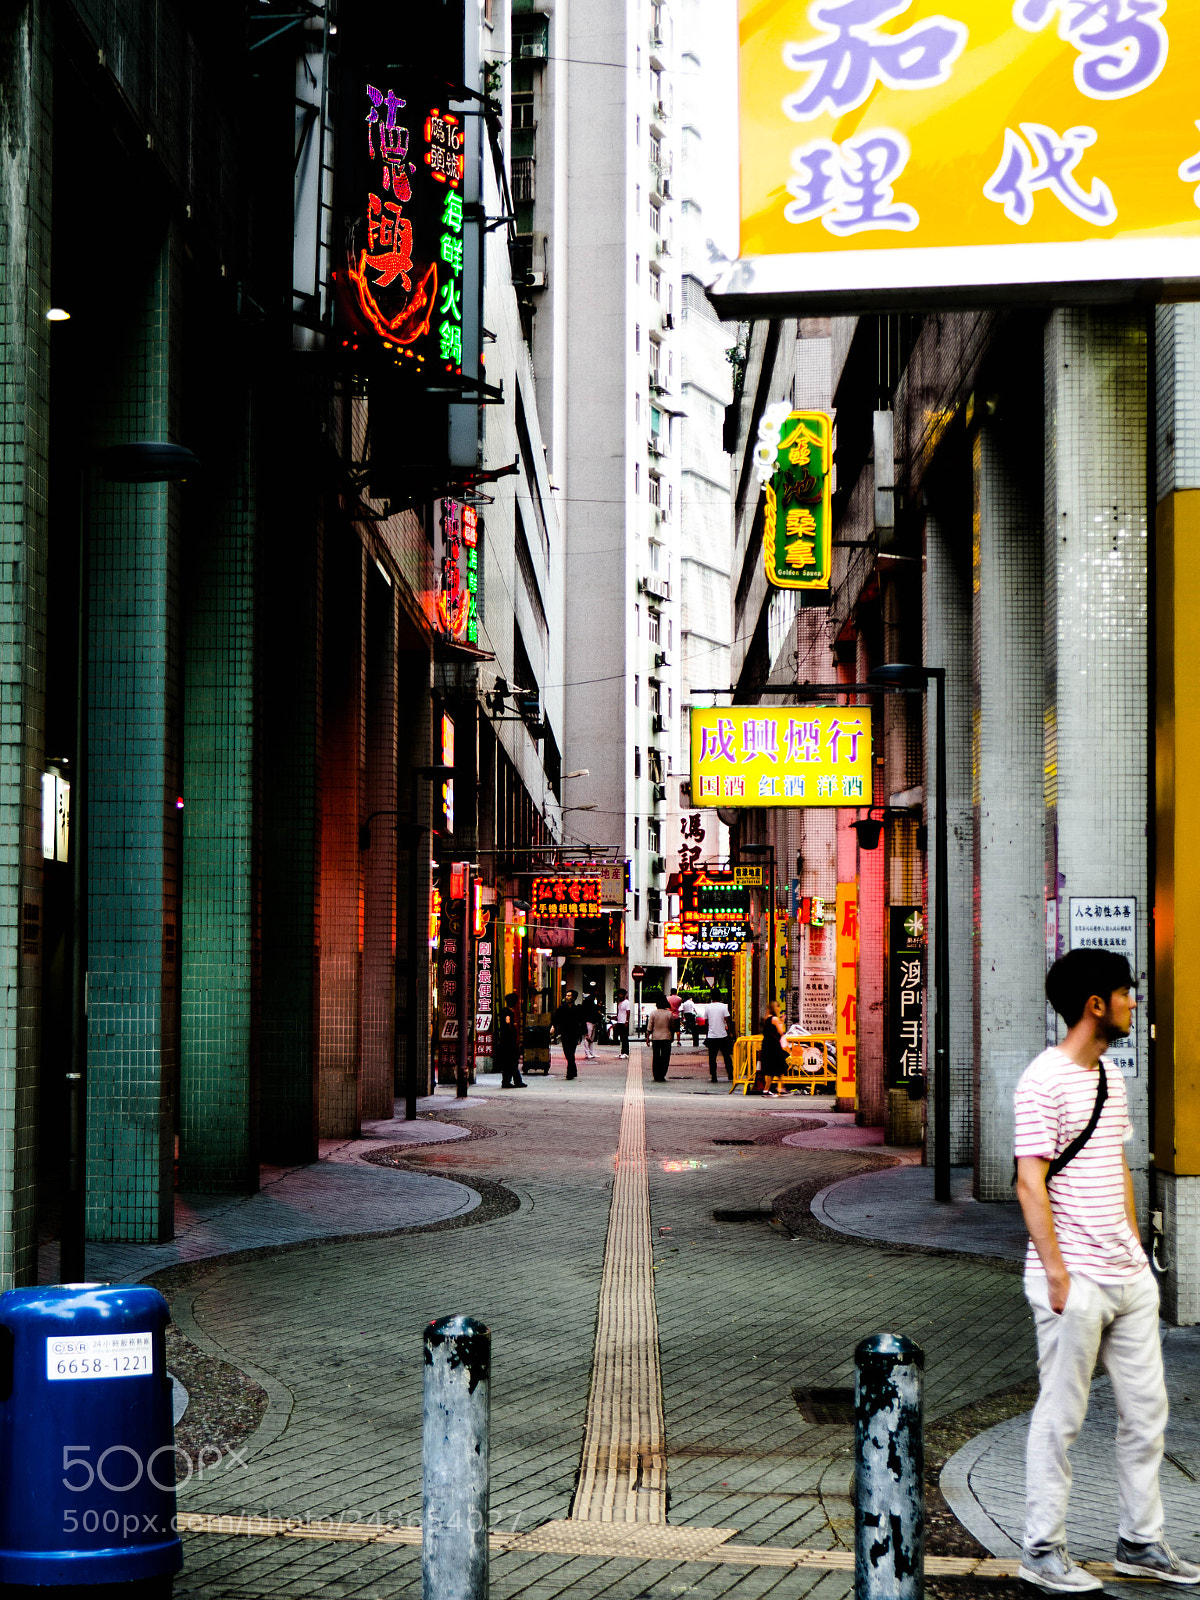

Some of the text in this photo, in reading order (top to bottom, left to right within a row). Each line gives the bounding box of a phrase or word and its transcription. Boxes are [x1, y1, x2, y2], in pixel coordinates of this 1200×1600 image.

[439, 189, 464, 366] 海鮮火鍋
[778, 423, 824, 569] 金池桑拿
[698, 718, 864, 763] 成興煙行
[699, 774, 864, 797] 国酒 红酒 洋酒
[1075, 905, 1131, 918] 人之初性本善
[478, 942, 492, 1011] 刷卡最便宜
[900, 958, 922, 1077] 澳門手信
[57, 1355, 147, 1374] 6658-1221
